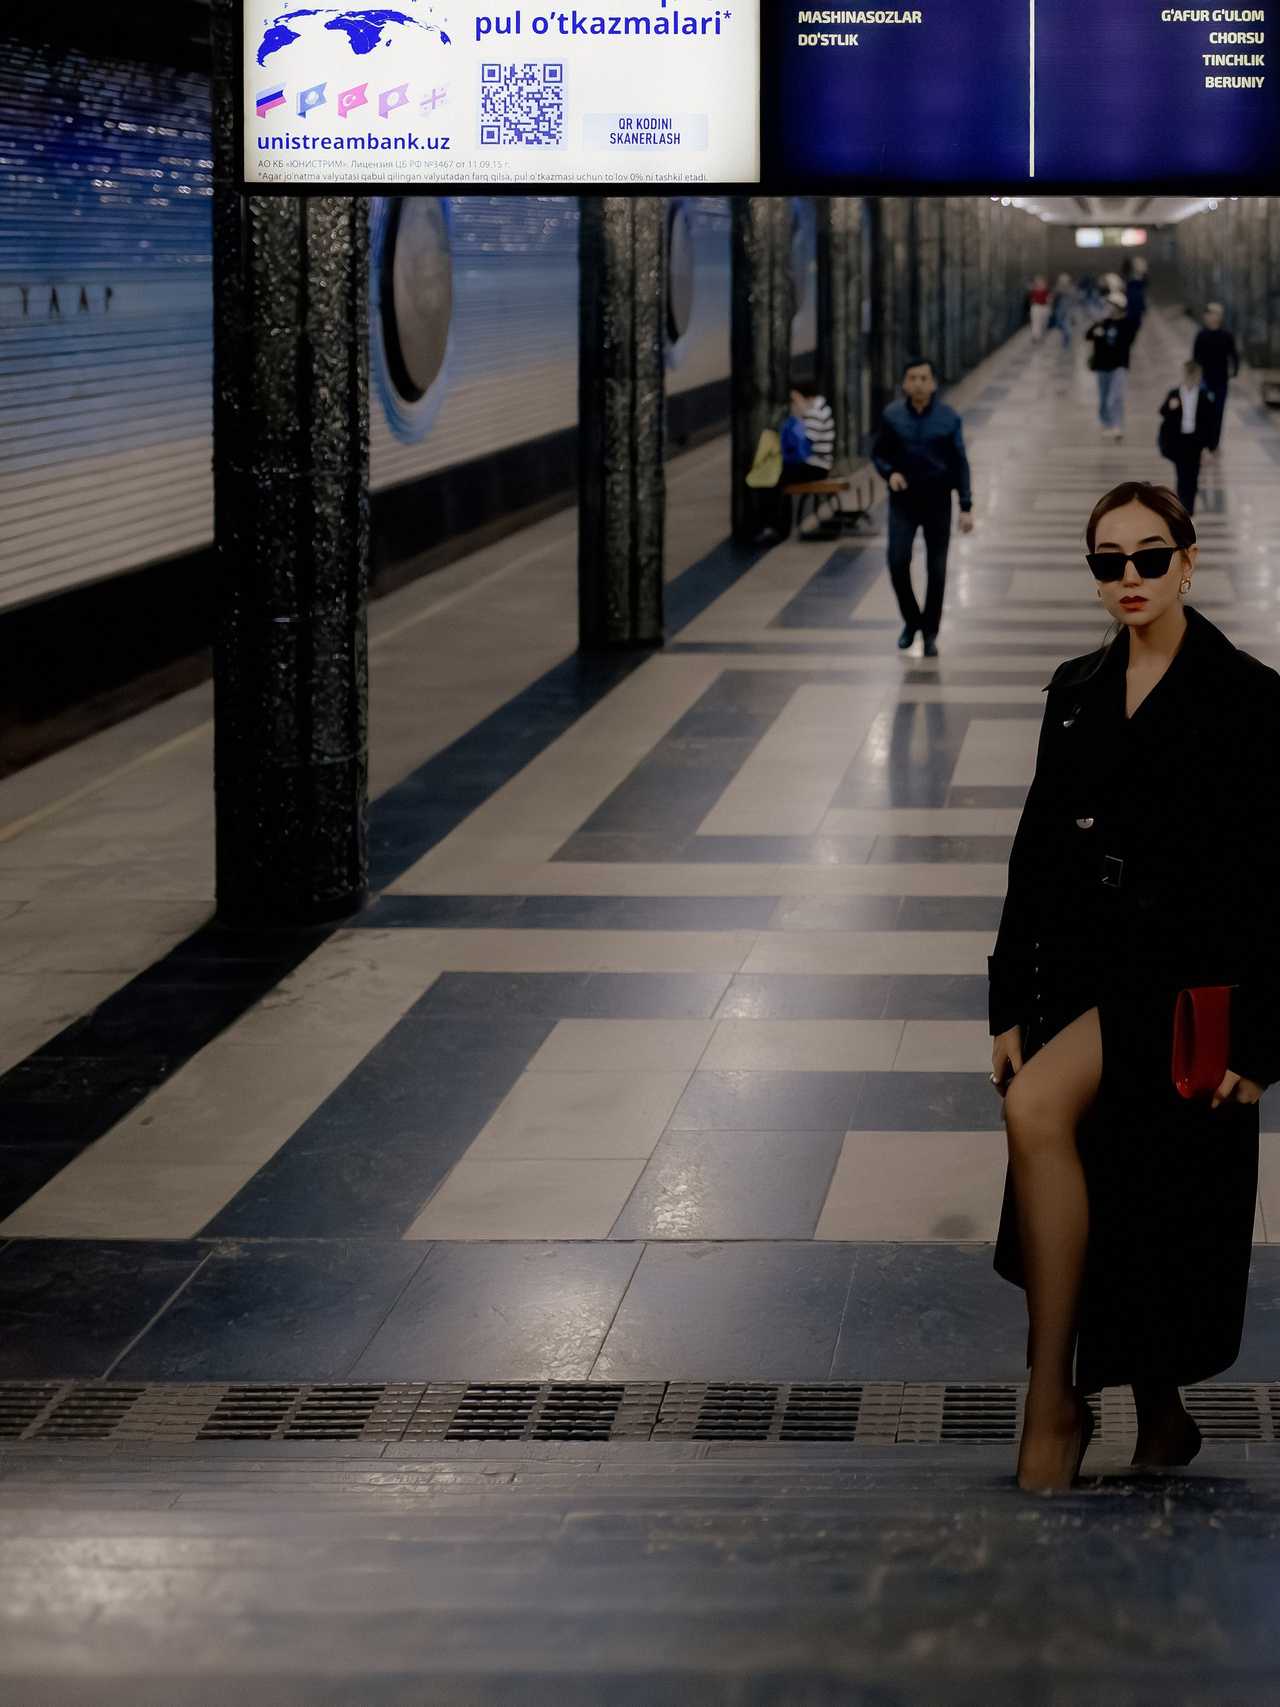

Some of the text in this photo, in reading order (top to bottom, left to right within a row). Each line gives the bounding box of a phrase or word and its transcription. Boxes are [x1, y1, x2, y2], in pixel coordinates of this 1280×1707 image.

[797, 10, 922, 24] MASHINASOZLAR
[1161, 8, 1265, 22] G‘AFUR G‘ULOM
[476, 10, 521, 42] pul
[797, 31, 859, 46] DO‘STLIK
[1208, 31, 1265, 44] CHORSU
[1201, 53, 1265, 67] TINCHLIK
[1204, 75, 1265, 89] BERUNIY
[618, 117, 672, 130] QR KODINI
[257, 132, 451, 150] unistreambank.uz
[609, 132, 681, 145] SKANERLASH
[257, 160, 271, 168] АО
[272, 160, 284, 168] КБ
[351, 160, 393, 169] Лицензия
[395, 160, 407, 169] ЦБ
[409, 160, 422, 169] РФ
[424, 160, 454, 168] №3467
[468, 160, 502, 168] 11.09.15
[322, 172, 359, 182] valyutasi
[361, 172, 386, 182] qabul
[387, 172, 422, 182] qilingan
[423, 172, 470, 182] valyutadan
[472, 172, 489, 182] farq
[514, 172, 528, 182] pul
[576, 172, 603, 181] uchun
[630, 172, 644, 181] 0%
[655, 172, 683, 181] tashkil
[684, 172, 709, 181] etadi.
